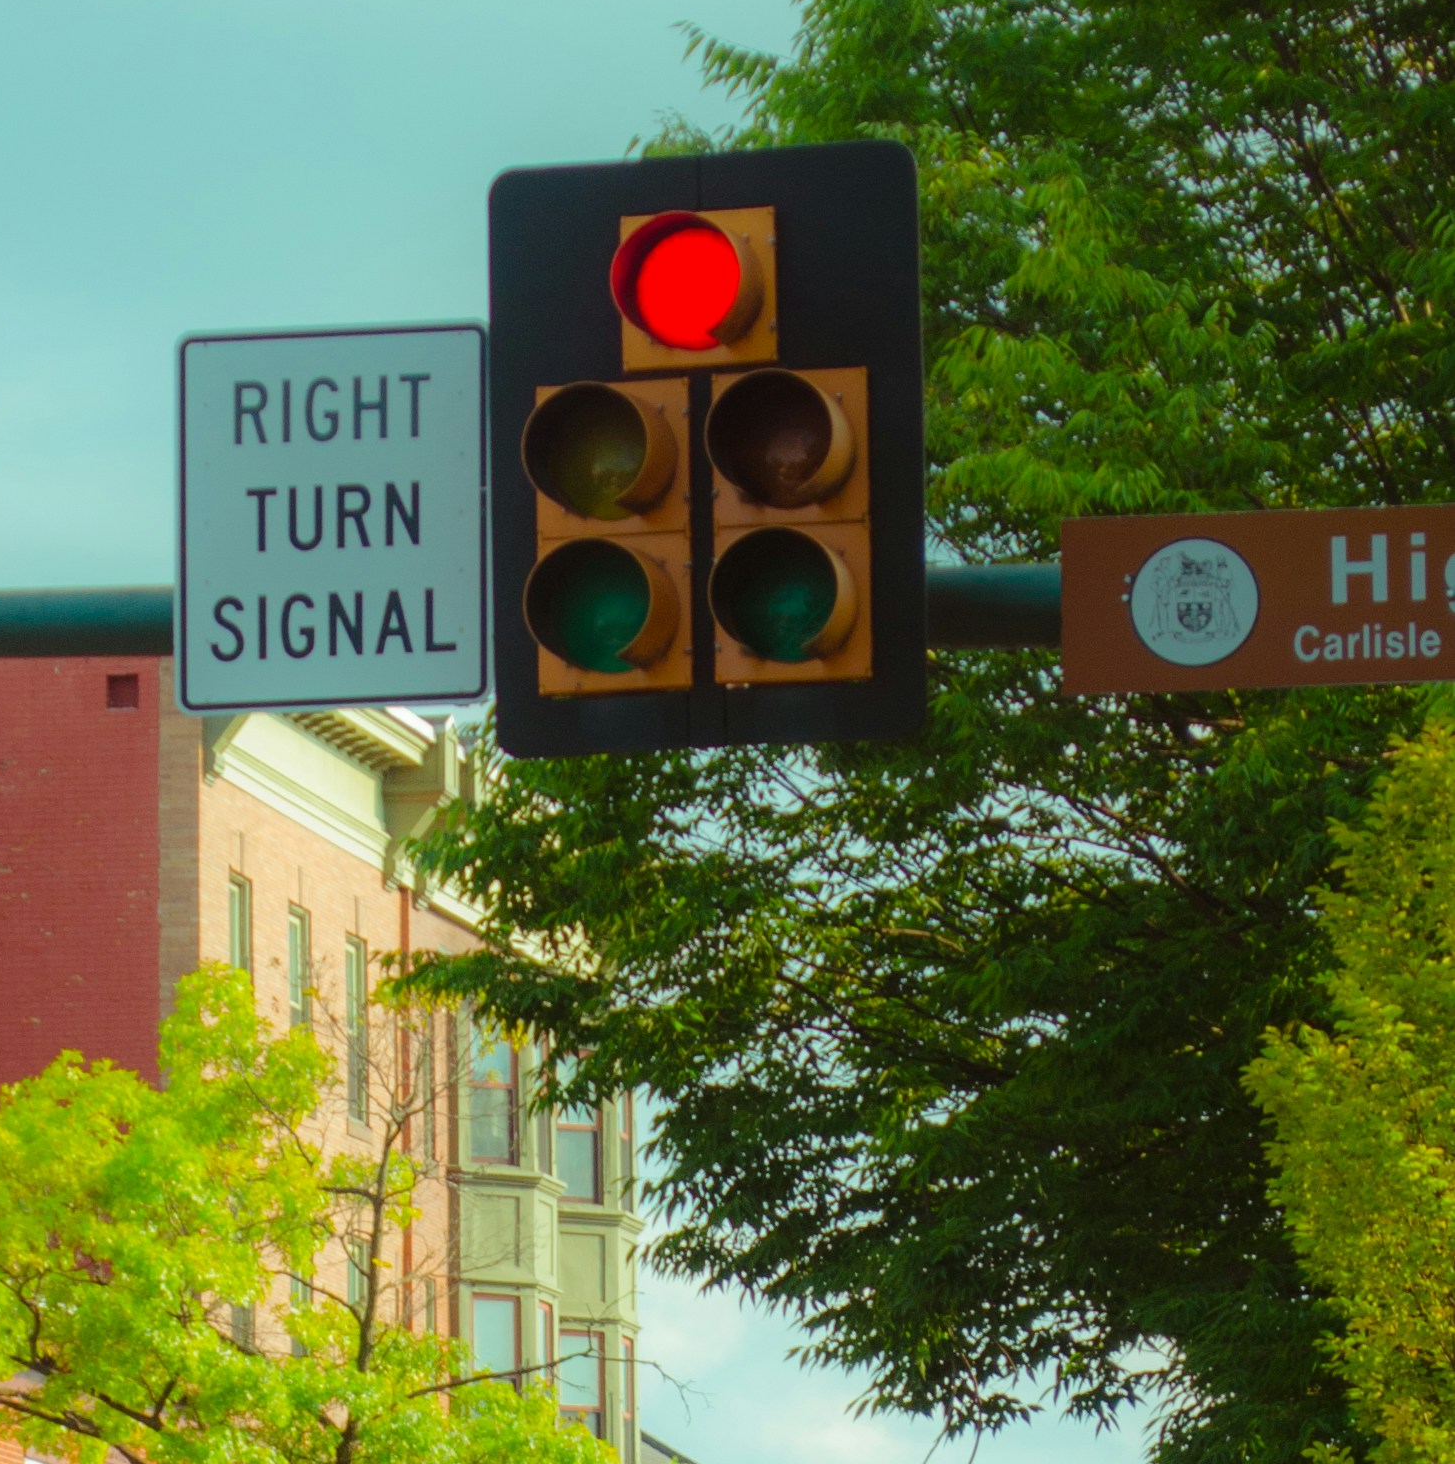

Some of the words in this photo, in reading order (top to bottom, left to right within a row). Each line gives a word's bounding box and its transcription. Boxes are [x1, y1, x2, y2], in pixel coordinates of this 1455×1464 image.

[234, 373, 431, 445] RIGHT
[246, 481, 421, 553] TURN
[1331, 531, 1455, 614] Hi
[211, 588, 457, 662] SIGNAL
[1293, 622, 1441, 663] Carlisle
